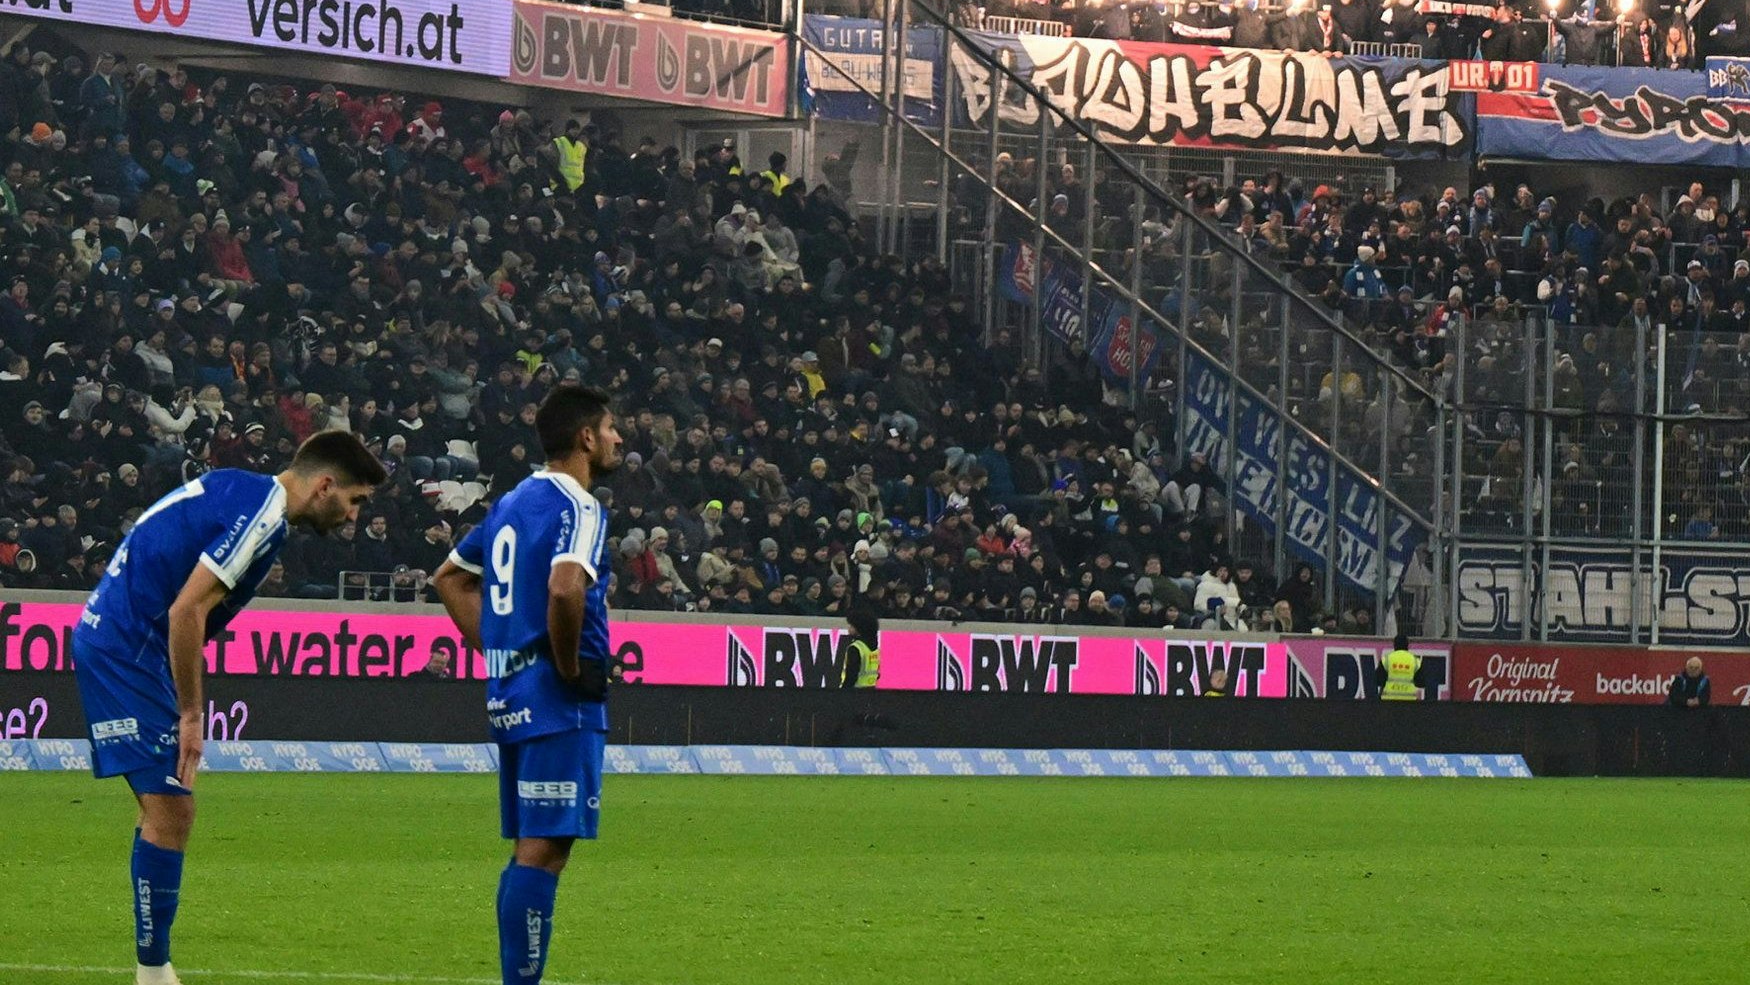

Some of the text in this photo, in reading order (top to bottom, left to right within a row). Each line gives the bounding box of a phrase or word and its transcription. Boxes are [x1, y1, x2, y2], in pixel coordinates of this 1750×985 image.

[541, 12, 640, 90] BWT
[682, 30, 775, 106] BWT
[490, 524, 517, 616] 9
[251, 619, 415, 677] water
[968, 634, 1080, 693] BWT
[1165, 640, 1267, 697] BWT
[1487, 654, 1557, 685] Original
[138, 877, 154, 931] LIWEST
